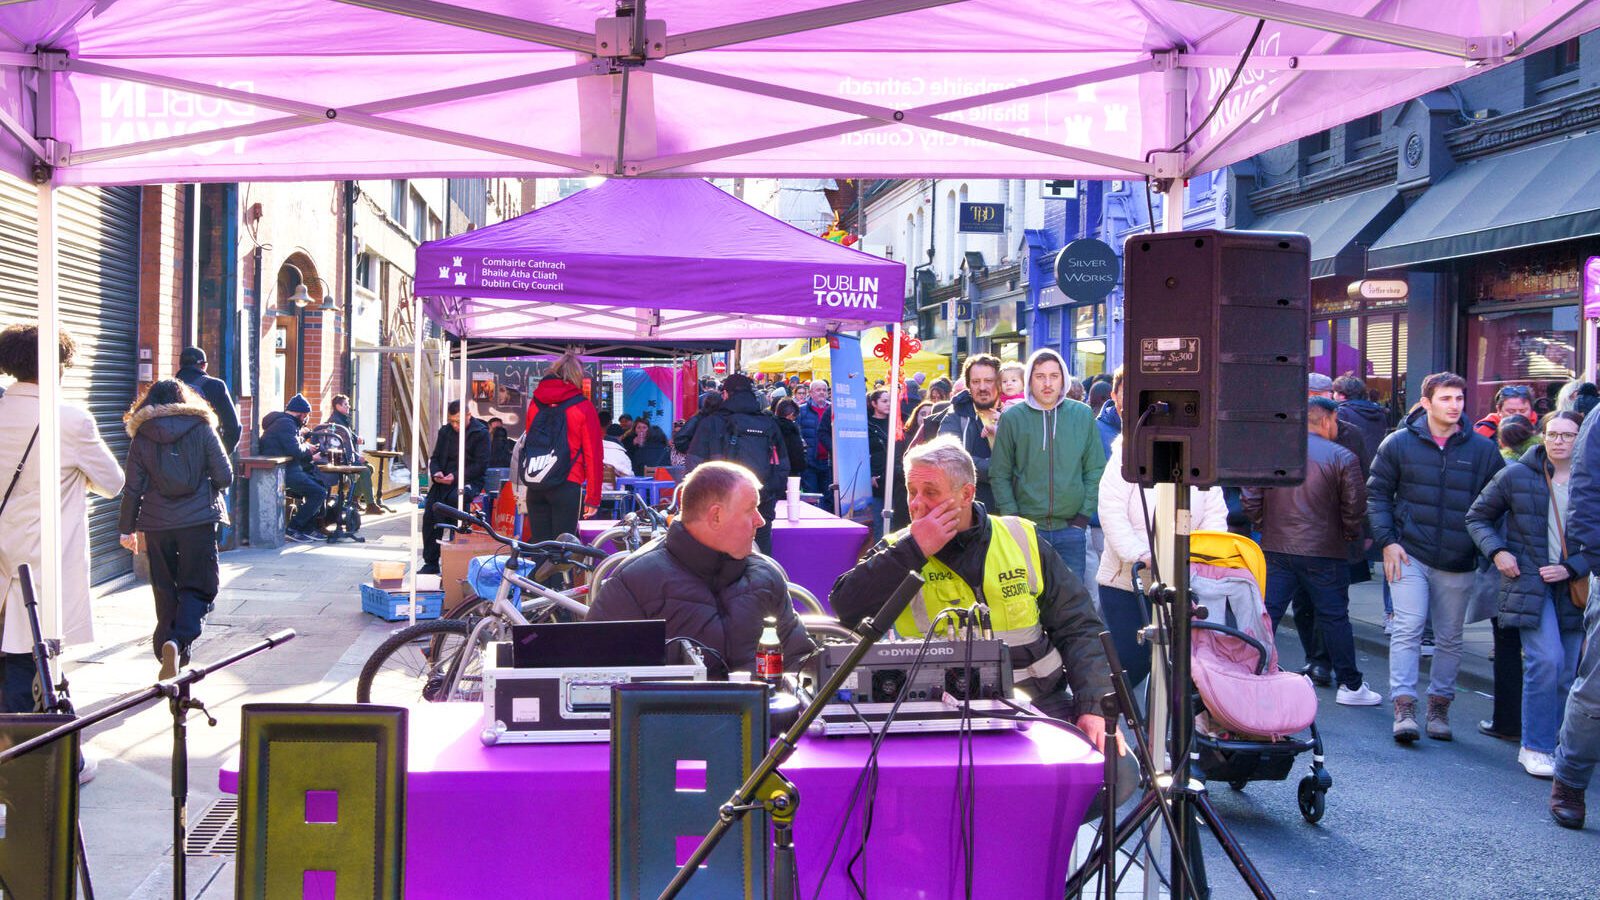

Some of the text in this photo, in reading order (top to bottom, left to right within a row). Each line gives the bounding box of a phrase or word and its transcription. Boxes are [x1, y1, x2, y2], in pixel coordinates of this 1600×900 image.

[482, 257, 566, 270] Comhairle Cathrach
[481, 268, 508, 278] Bhaile
[532, 270, 558, 280] Cliath
[481, 278, 564, 291] Dublin City Council
[813, 273, 879, 293] DUBLIN
[813, 289, 878, 309] TOWN
[998, 568, 1026, 583] PULSE
